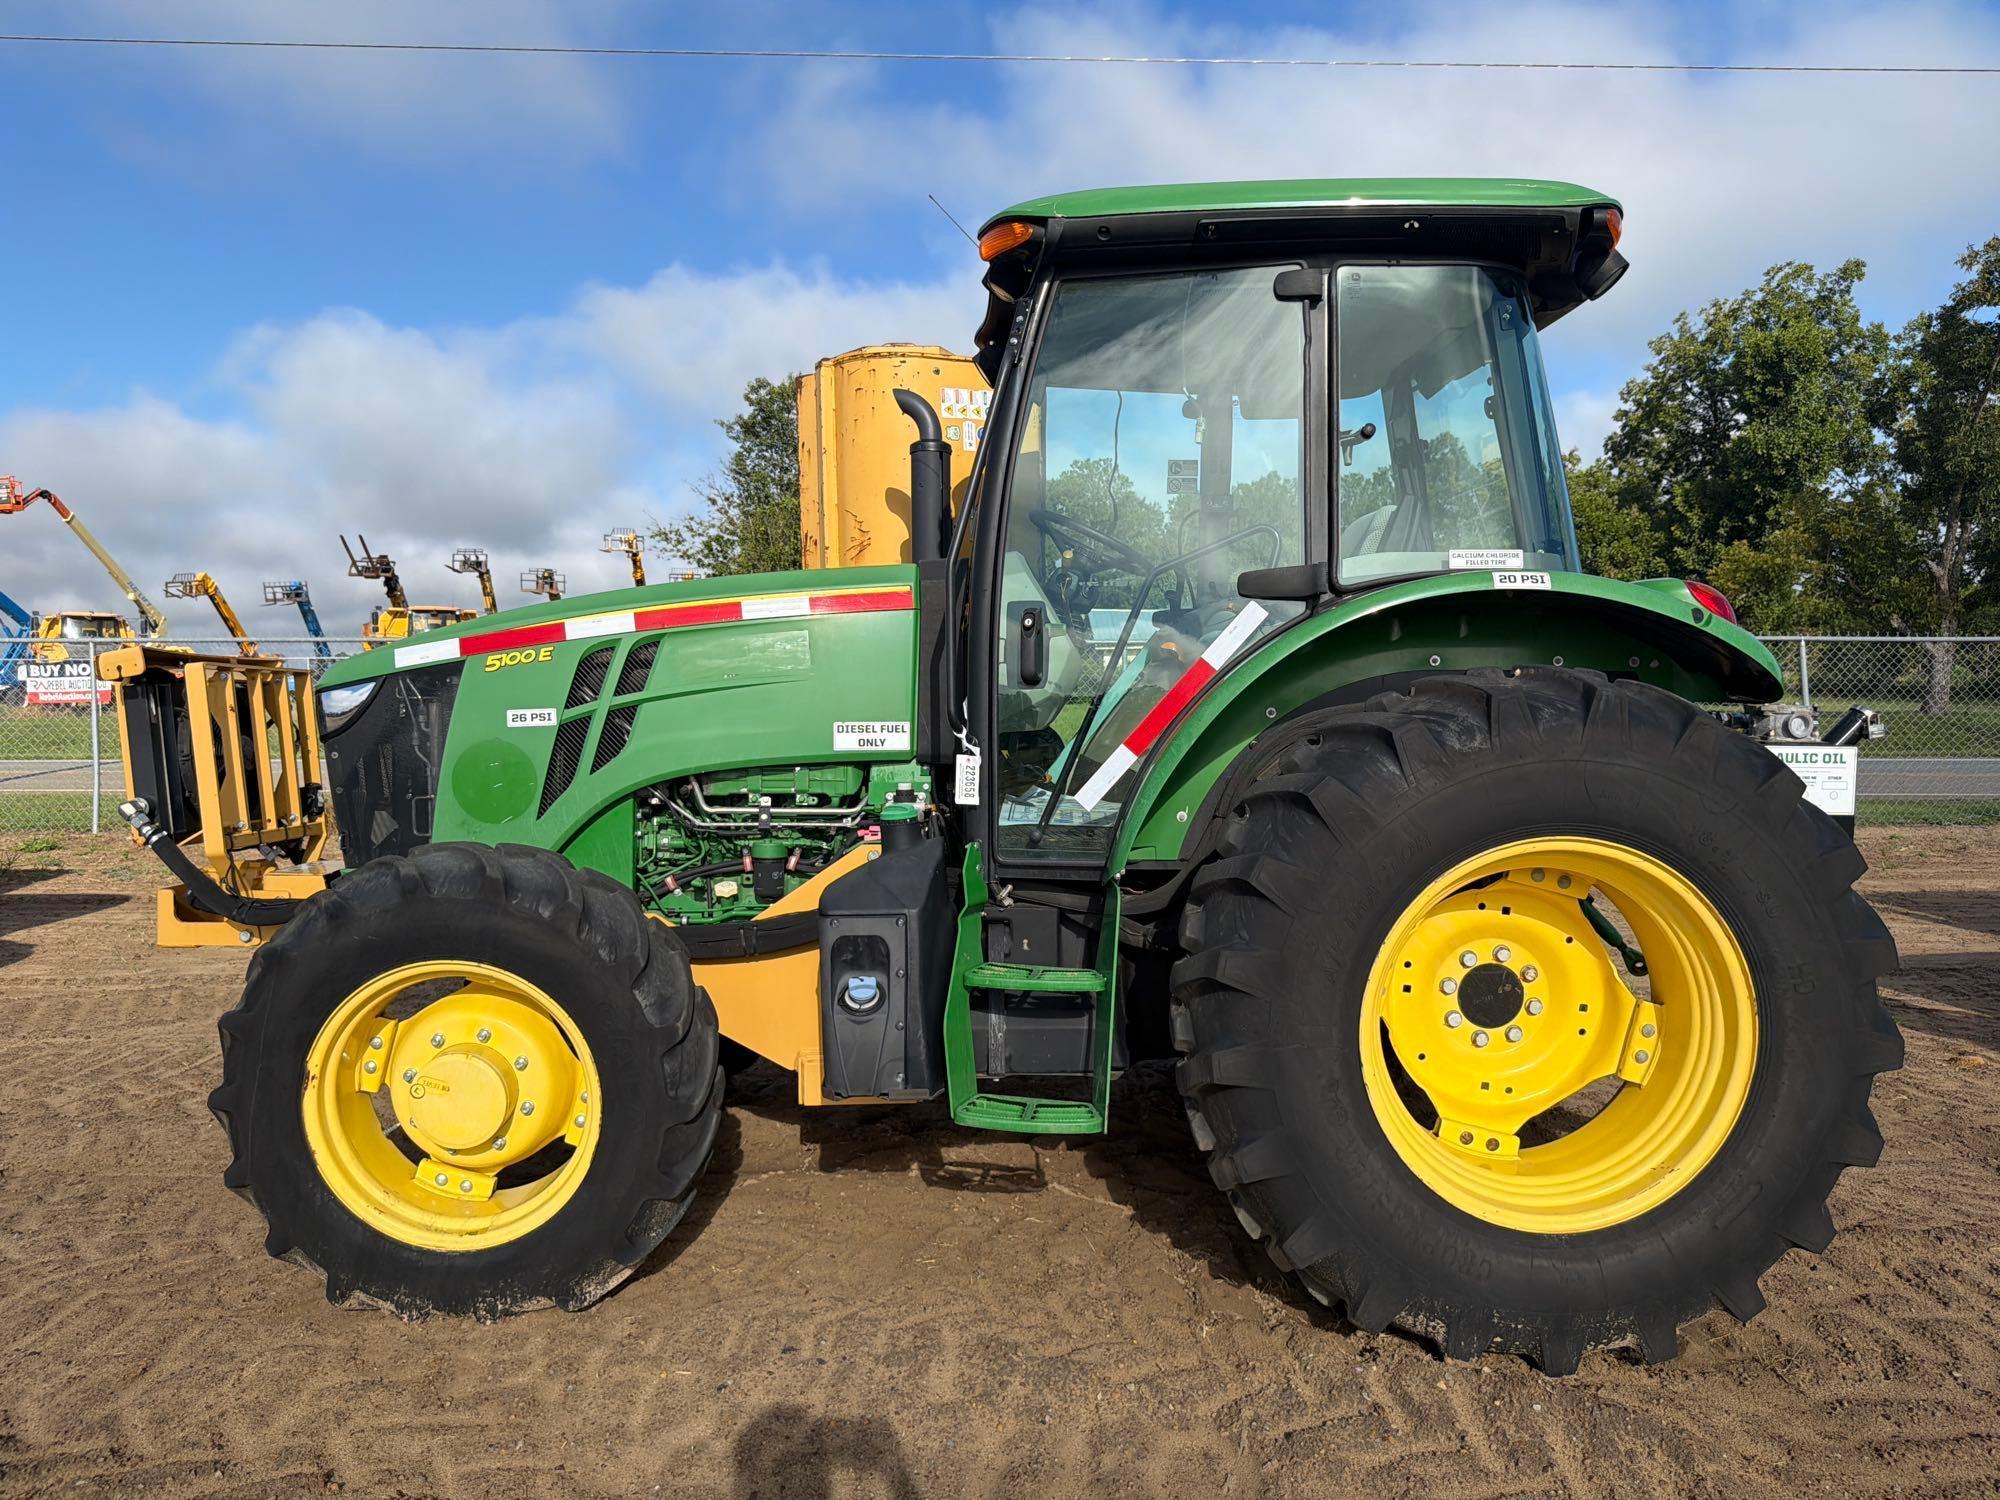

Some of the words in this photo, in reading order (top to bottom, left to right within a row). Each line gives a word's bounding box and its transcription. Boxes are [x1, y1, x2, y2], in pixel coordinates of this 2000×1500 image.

[1498, 574, 1517, 584] 20
[1521, 574, 1546, 584] PSI
[484, 649, 537, 672] 5100
[538, 646, 555, 662] E
[30, 663, 61, 677] BUY
[64, 663, 91, 676] NO
[511, 713, 527, 723] 26
[530, 712, 553, 722] PSI
[836, 724, 878, 734] DIESEL
[880, 724, 907, 734] FUEL
[858, 738, 886, 748] ONLY
[1777, 752, 1819, 764] AULIC
[1822, 752, 1847, 764] OIL
[964, 764, 976, 799] 223658
